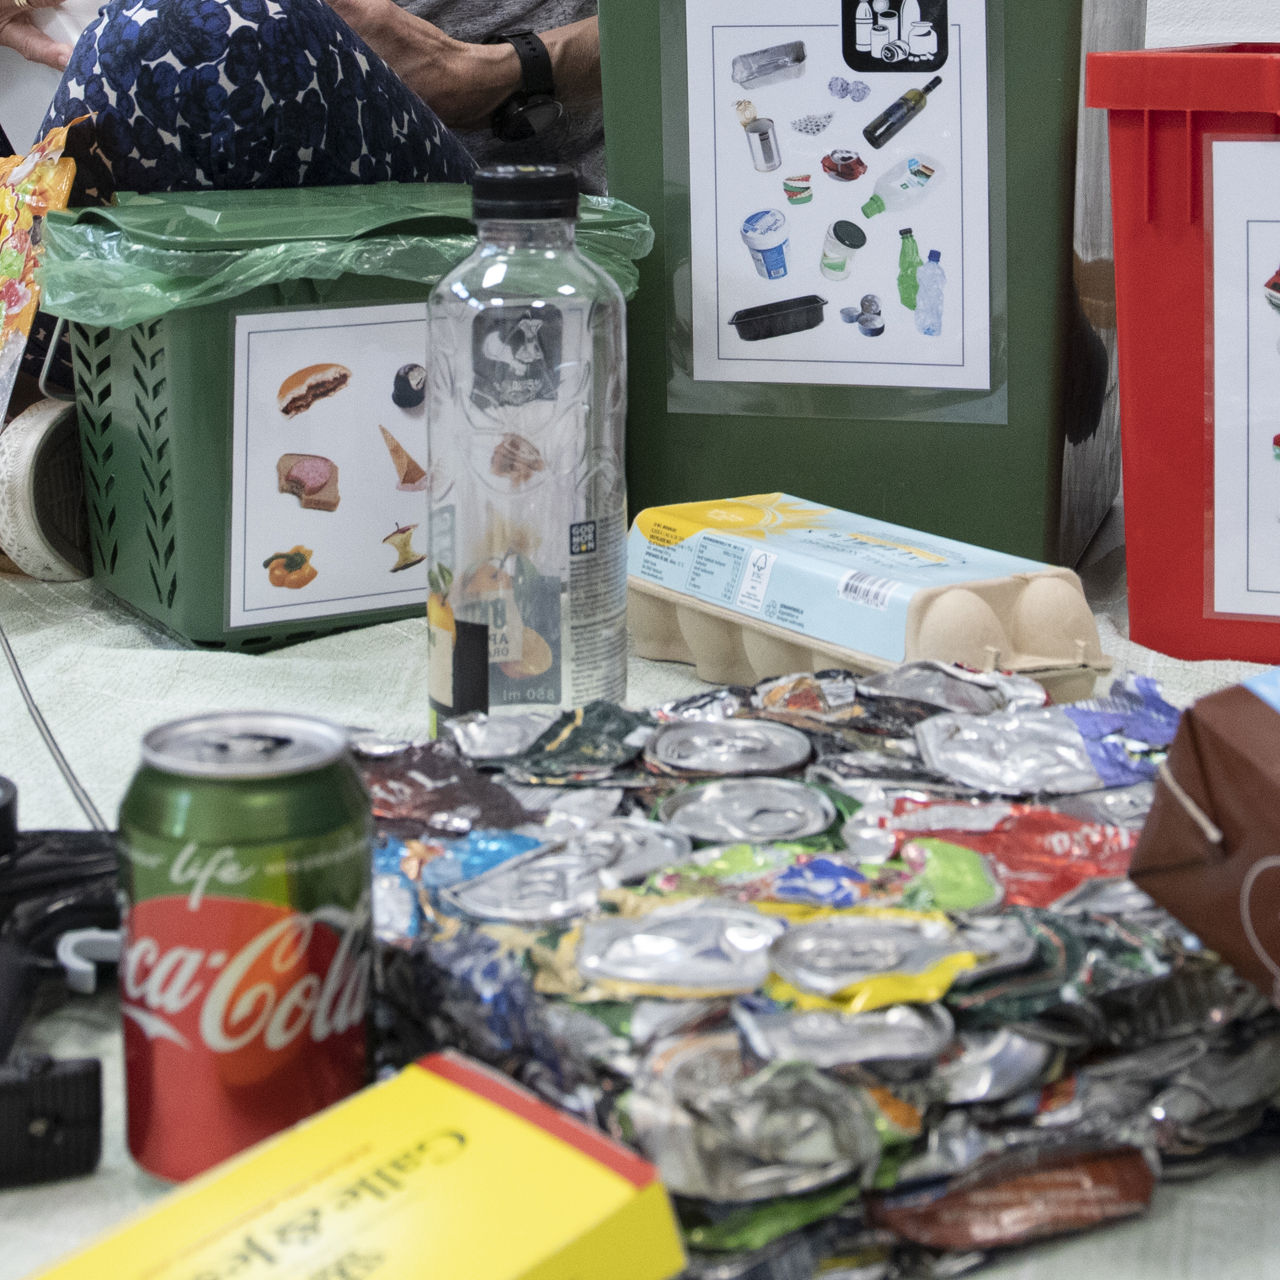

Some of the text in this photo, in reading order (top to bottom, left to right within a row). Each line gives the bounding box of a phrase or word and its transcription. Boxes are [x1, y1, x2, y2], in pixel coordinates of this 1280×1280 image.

[572, 523, 595, 535] GOD
[572, 533, 595, 543] MOR
[169, 841, 257, 912] life
